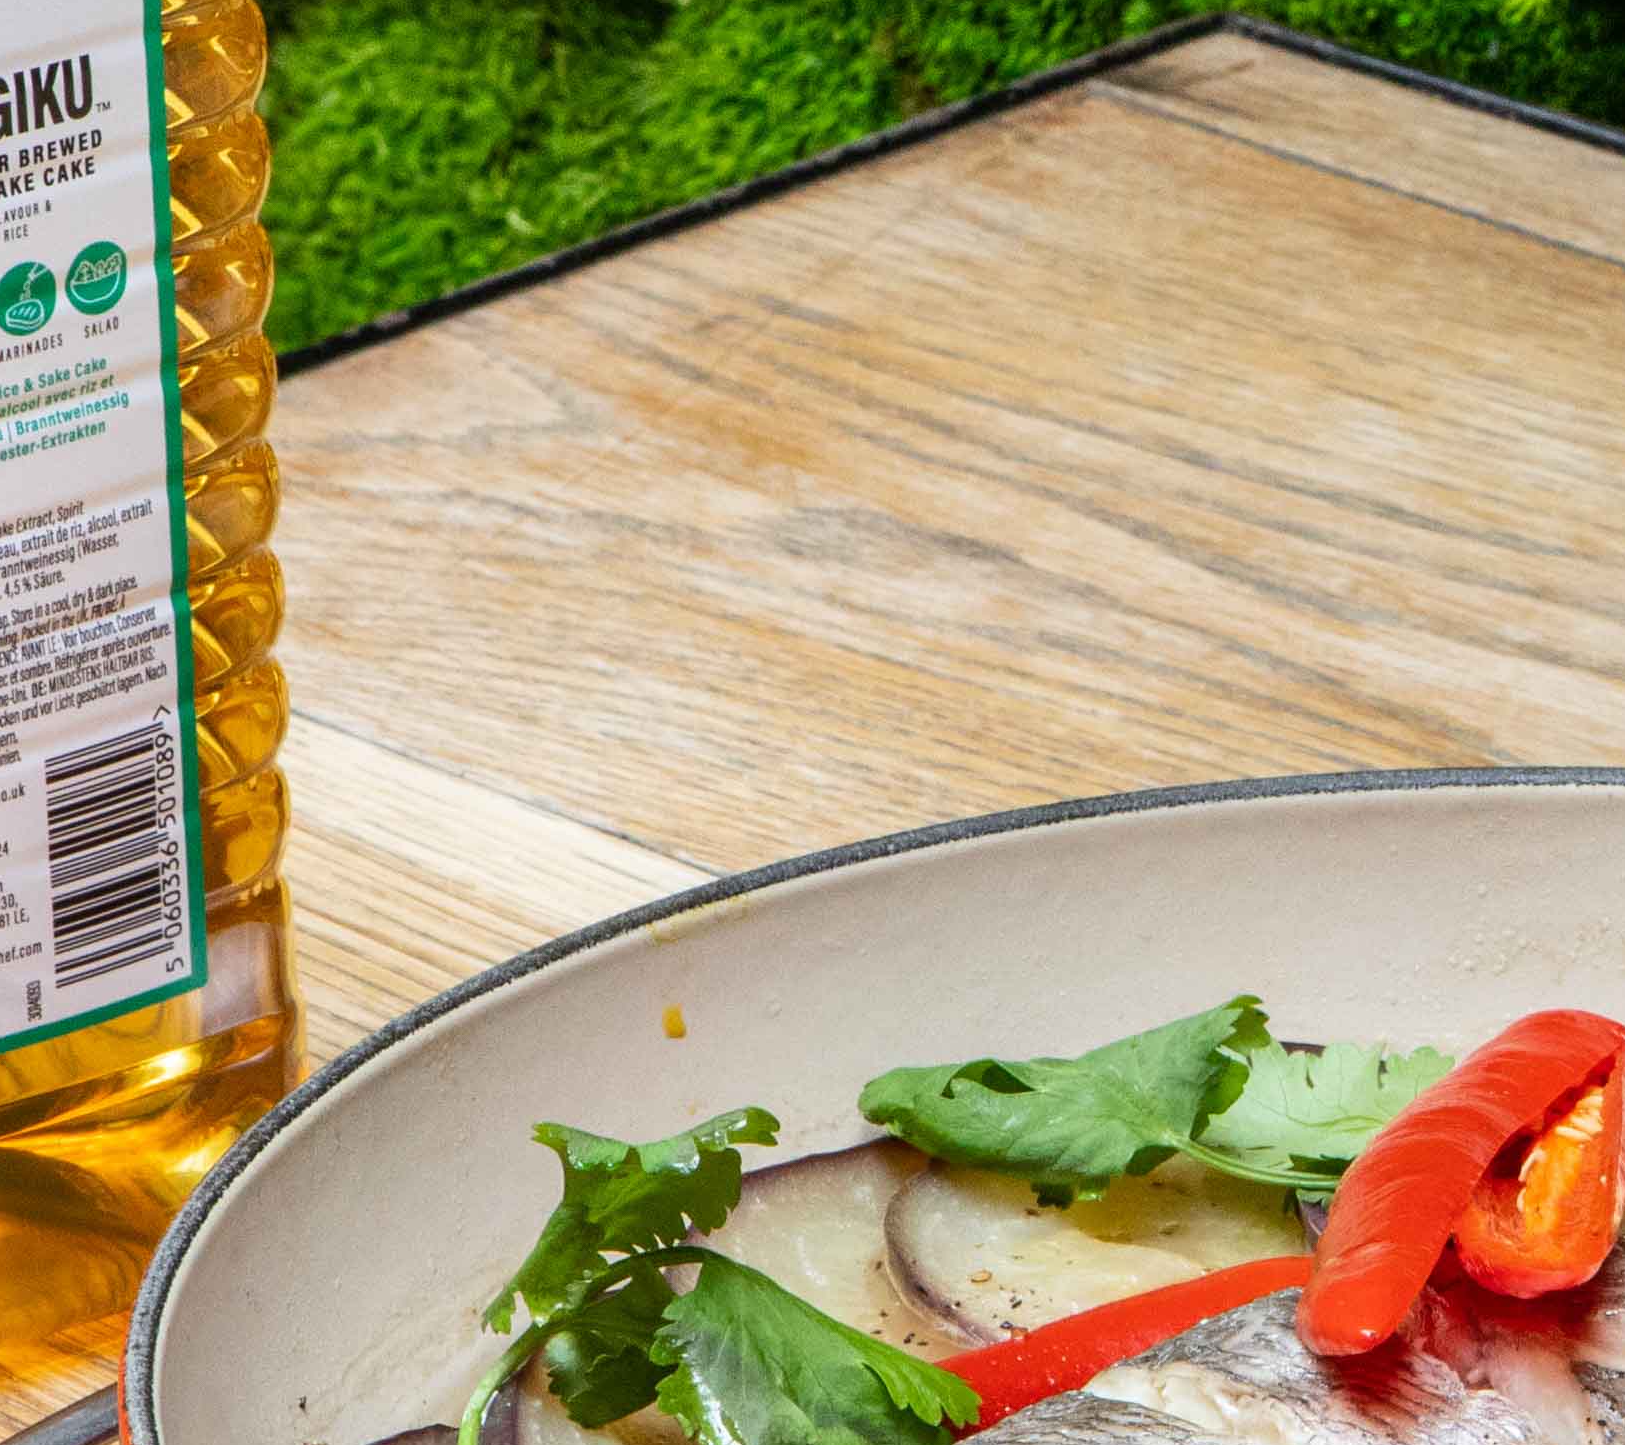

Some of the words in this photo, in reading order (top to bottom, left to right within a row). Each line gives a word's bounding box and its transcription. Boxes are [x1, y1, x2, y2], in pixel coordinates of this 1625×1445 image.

[18, 128, 102, 169] BREWED
[43, 155, 95, 187] CAKE
[45, 199, 52, 212] &
[3, 223, 29, 242] RICE
[84, 316, 119, 339] SALAD
[23, 377, 34, 394] &
[37, 368, 71, 389] Sake
[74, 358, 107, 379] Cake
[44, 387, 76, 406] avec
[79, 380, 98, 396] riz
[99, 374, 115, 390] et
[14, 391, 130, 436] Branntweinessig
[15, 509, 56, 534] Extract,
[56, 500, 84, 522] Spirit
[21, 529, 56, 554] extrait
[55, 525, 69, 544] de
[70, 521, 87, 539] riz,
[86, 509, 121, 535] alcool,
[120, 499, 153, 524] extrait
[77, 532, 119, 559] (Wasser,
[33, 569, 66, 591] Säure.
[154, 732, 177, 830] 501089
[159, 840, 183, 940] 060336
